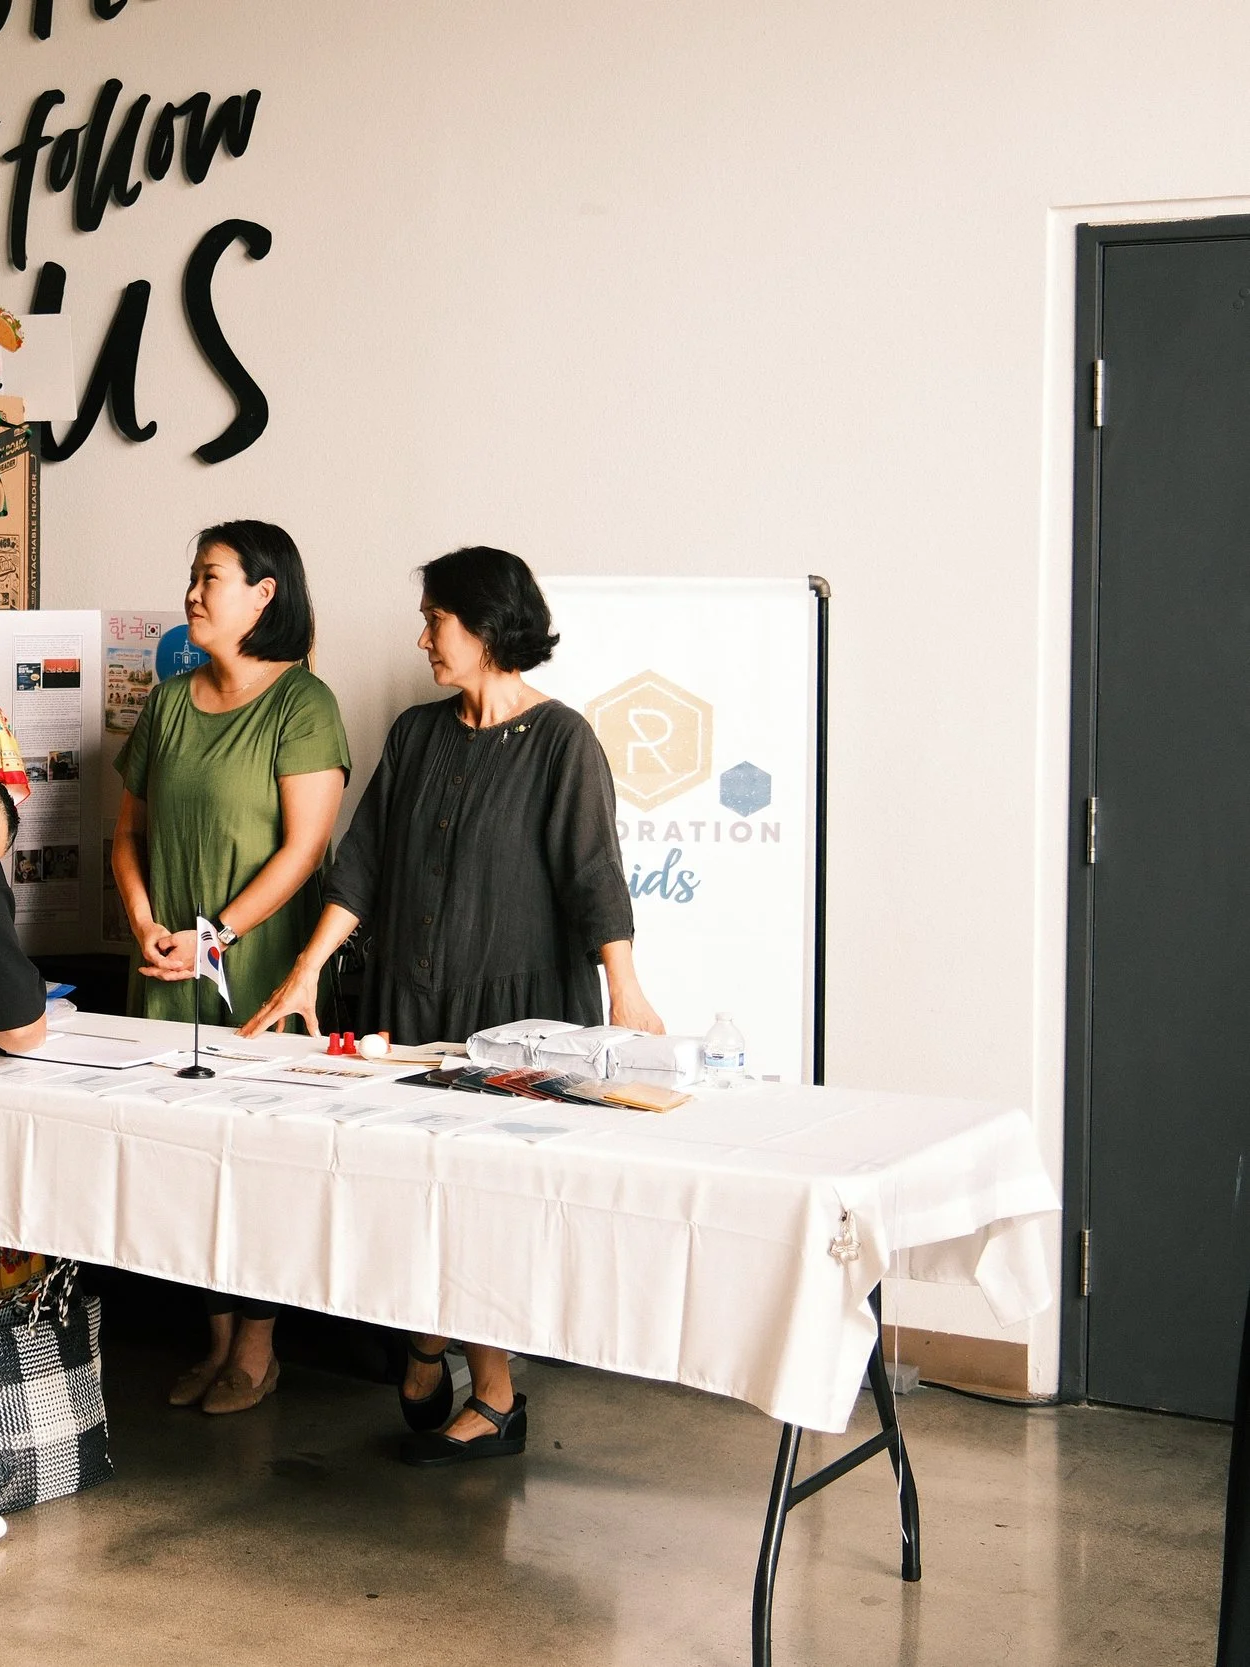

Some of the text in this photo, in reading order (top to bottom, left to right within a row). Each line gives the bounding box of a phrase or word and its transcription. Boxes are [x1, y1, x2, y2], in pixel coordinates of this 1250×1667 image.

[3, 78, 261, 271] follow
[109, 616, 144, 641] 한국
[623, 848, 701, 904] ids
